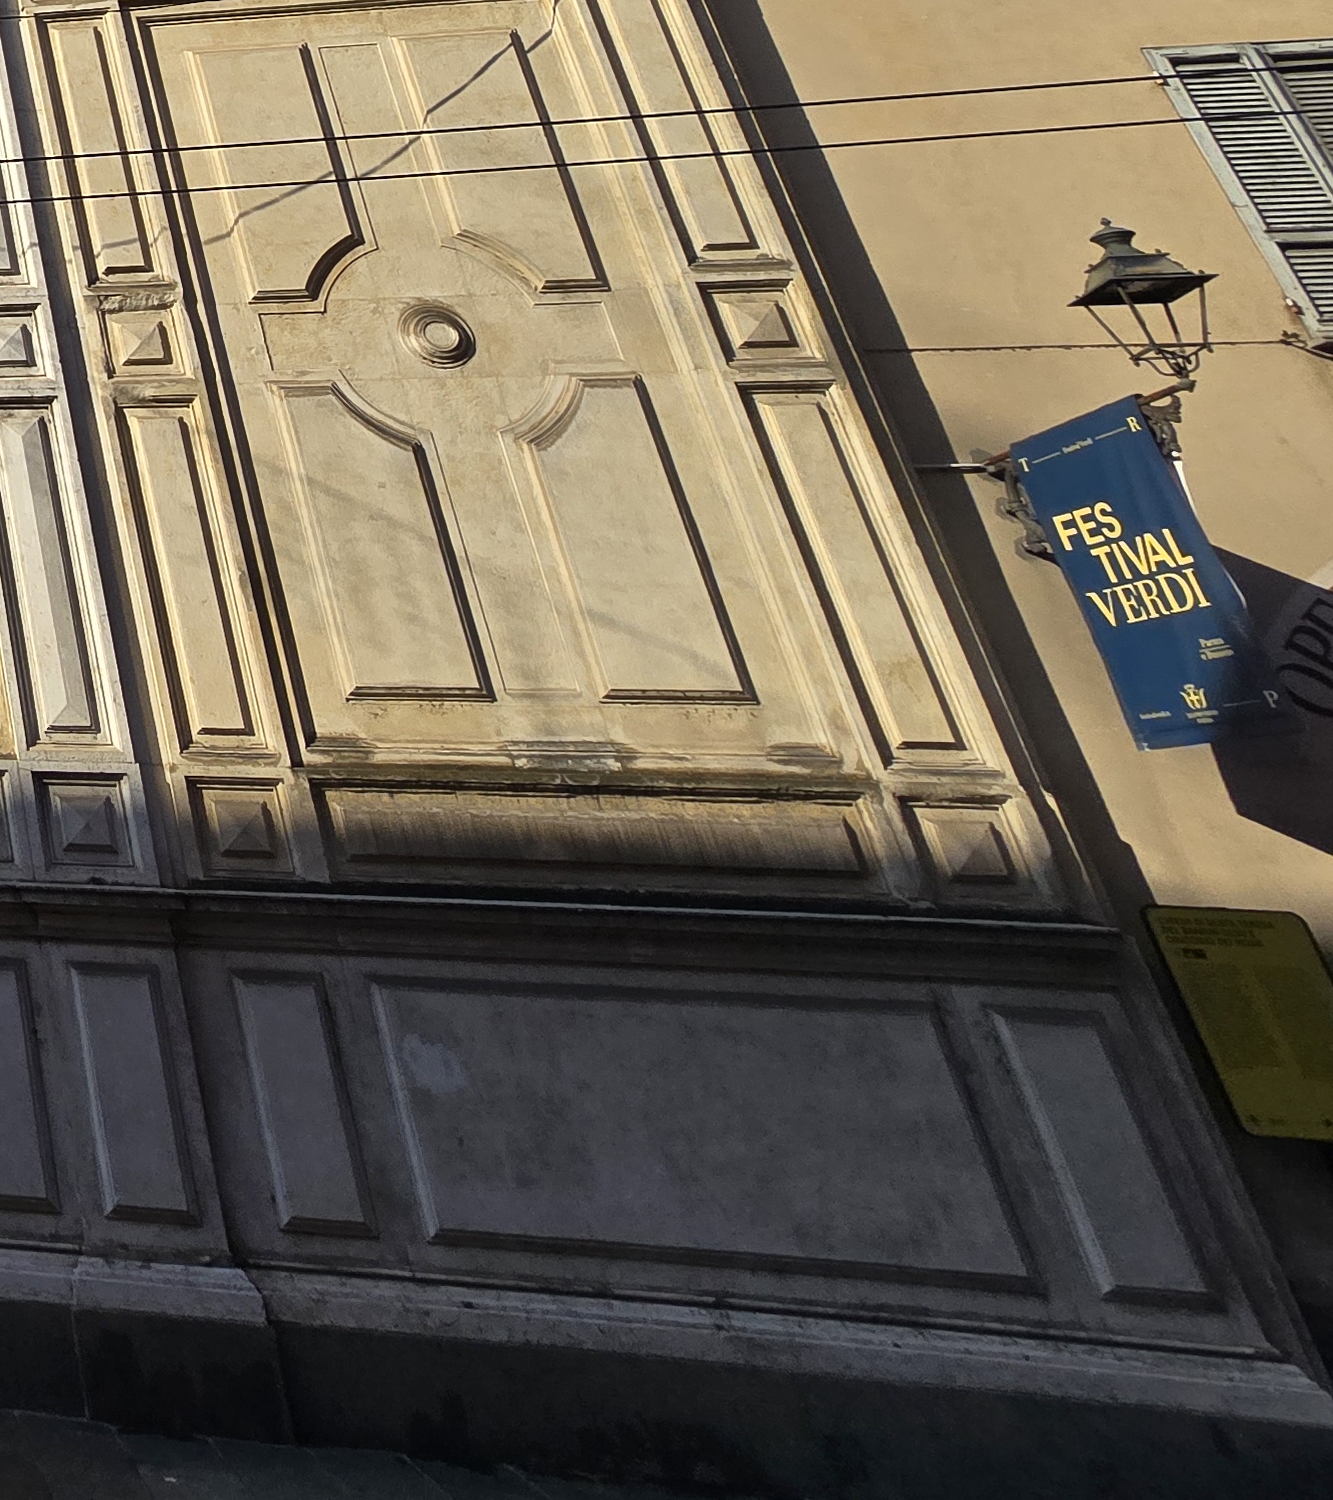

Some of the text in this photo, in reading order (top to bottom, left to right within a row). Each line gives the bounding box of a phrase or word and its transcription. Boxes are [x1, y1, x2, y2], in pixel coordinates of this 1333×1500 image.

[1126, 416, 1142, 432] R
[1052, 502, 1122, 551] FES
[1090, 528, 1194, 584] TIVAL
[1086, 568, 1212, 627] VERDI
[1262, 690, 1279, 708] P
